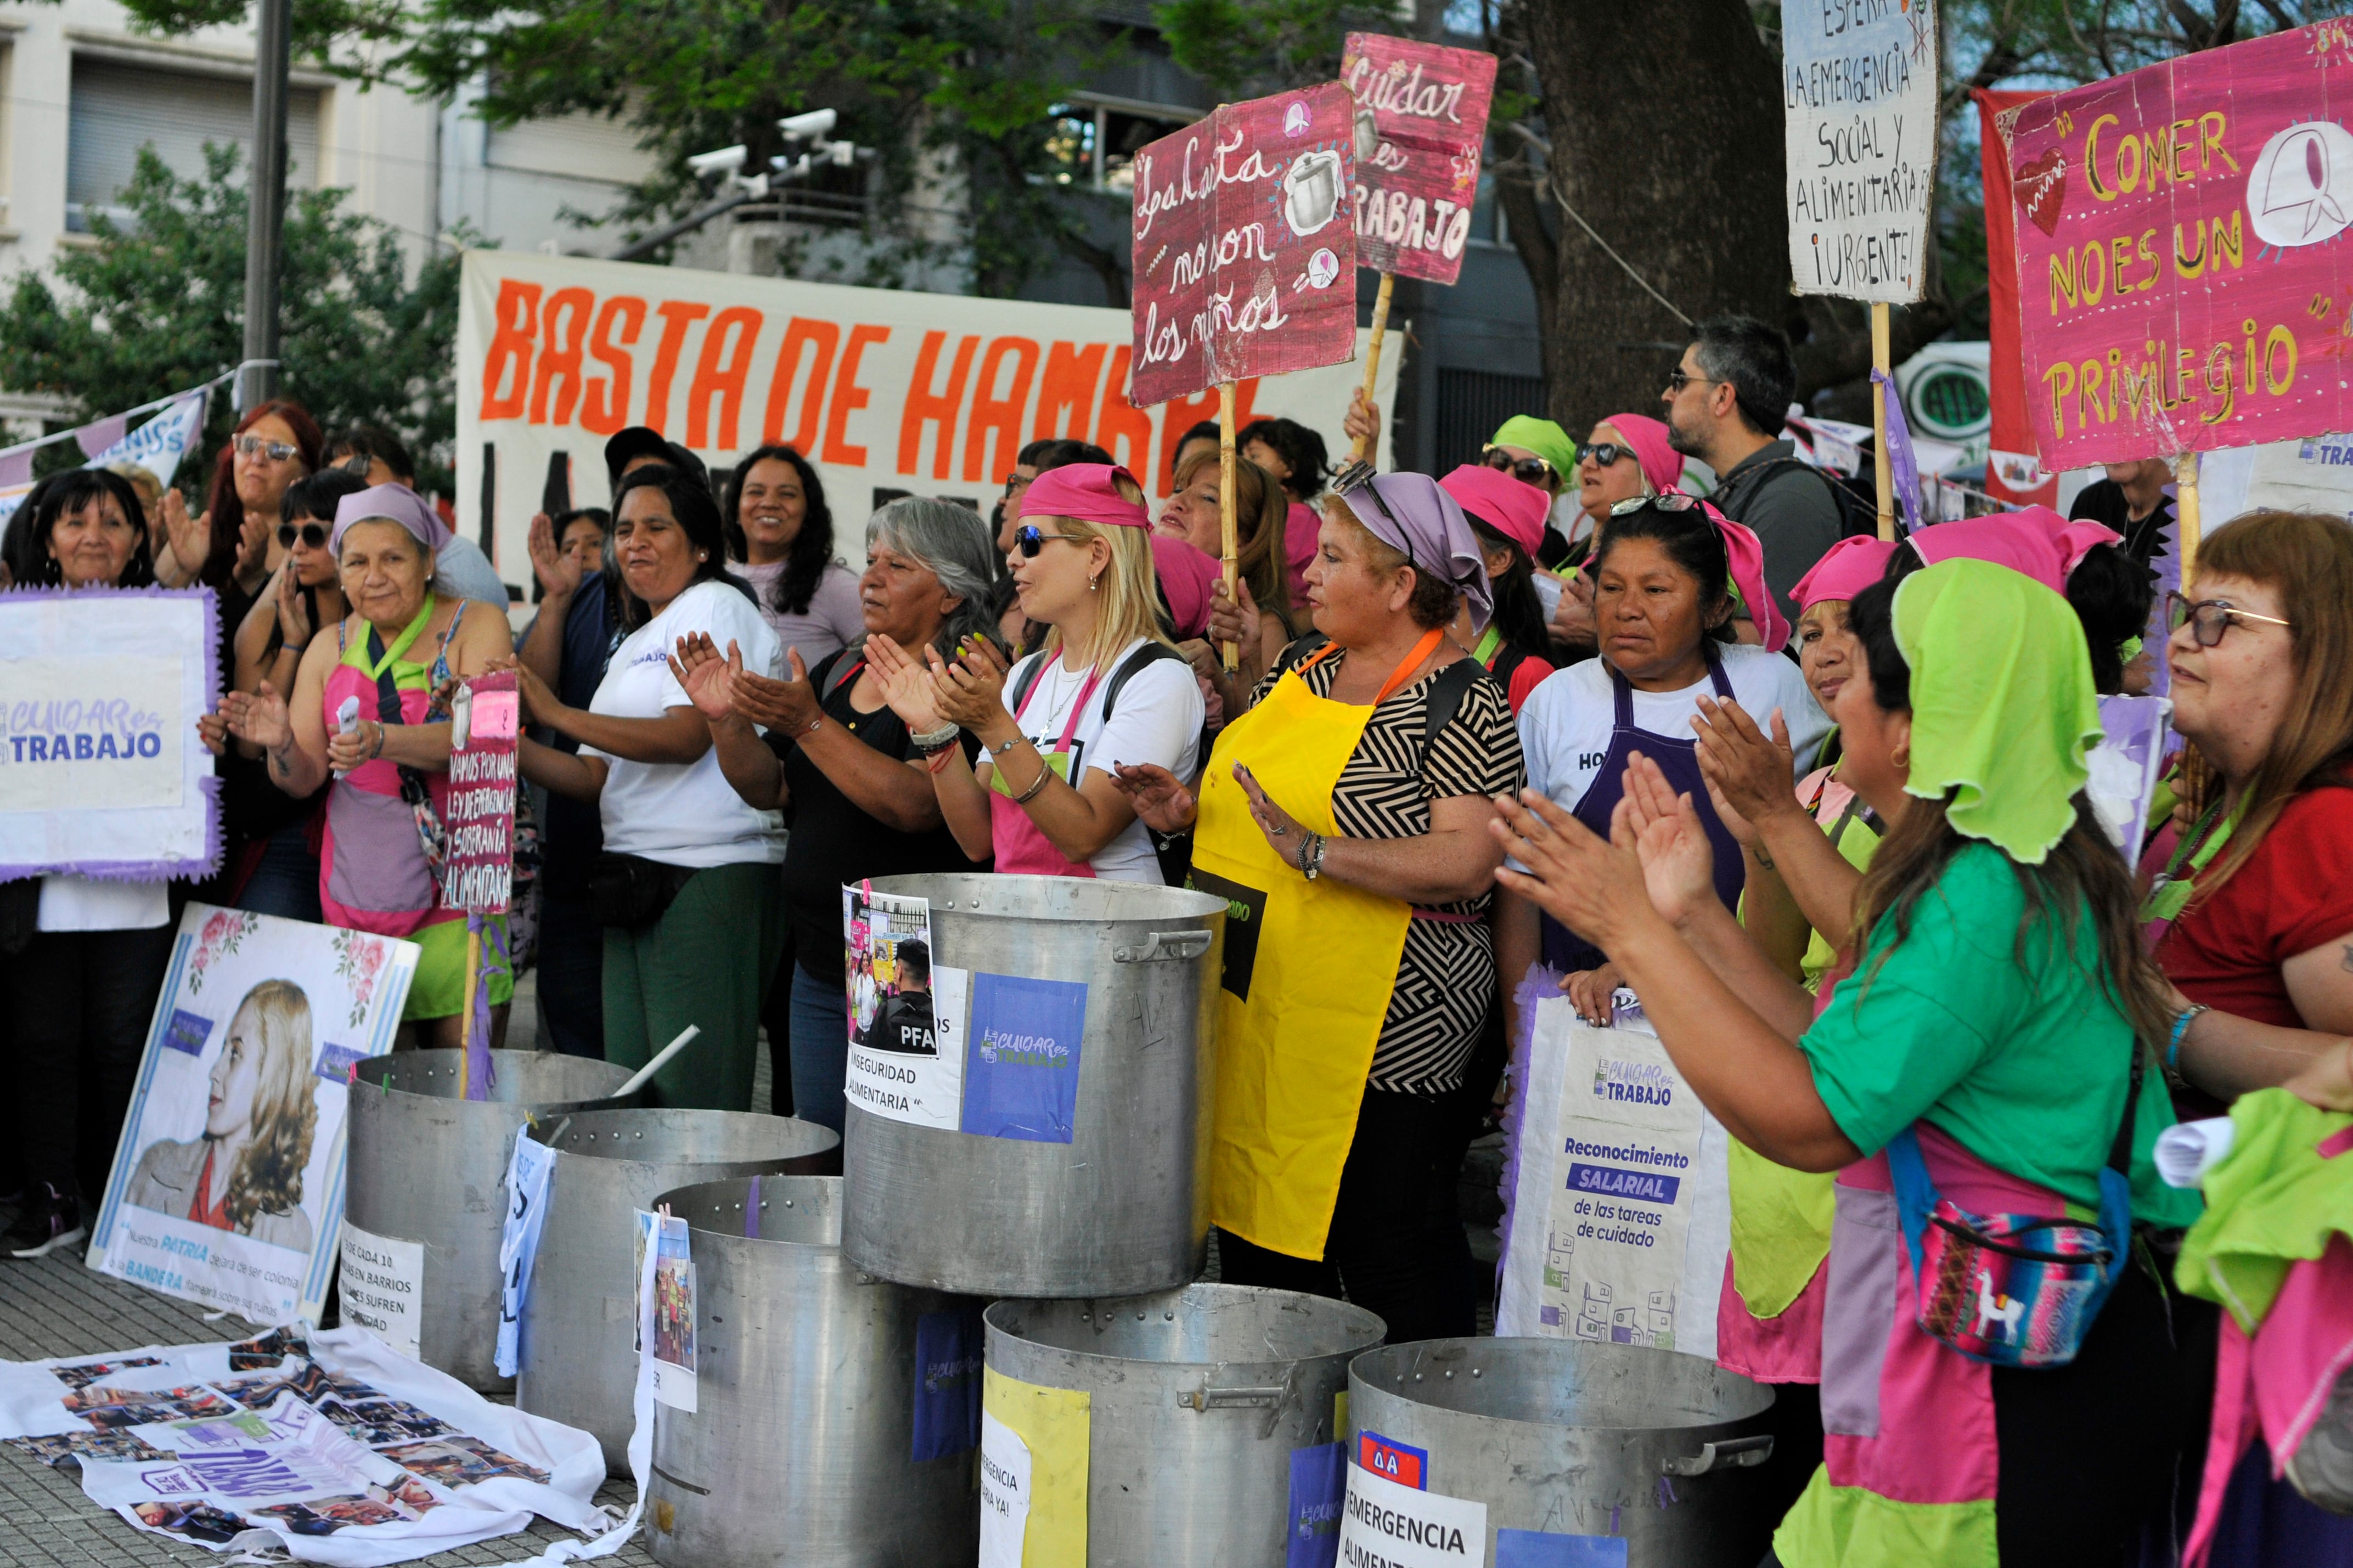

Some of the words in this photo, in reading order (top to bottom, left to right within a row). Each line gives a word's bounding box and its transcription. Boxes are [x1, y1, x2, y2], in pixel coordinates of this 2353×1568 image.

[1348, 57, 1465, 124] Cuidar
[1786, 63, 1808, 109] LA
[1894, 114, 1902, 167] Y
[1370, 142, 1408, 172] es
[1351, 184, 1471, 261] RABAJO
[2175, 210, 2243, 279] UN
[1138, 301, 1187, 370] los
[480, 278, 763, 451] BASTA
[763, 317, 891, 467] DE
[898, 329, 1275, 500] HAMBR
[10, 731, 161, 762] TRABAJO
[1579, 751, 1609, 770] HO
[450, 751, 479, 785] VAMOS
[480, 751, 496, 783] POR
[497, 751, 514, 781] UNA
[901, 1025, 936, 1048] PFA
[998, 1033, 1056, 1058] CUIDAR
[851, 1050, 916, 1084] INSEGURIDAD
[998, 1049, 1068, 1069] TRABAJO
[1609, 1061, 1663, 1091] CUIDAR
[848, 1079, 909, 1112] ALIMENTARIA
[1607, 1082, 1671, 1106] TRABAJO
[1564, 1137, 1689, 1169] Reconocimiento
[1578, 1169, 1664, 1199] SALARIAL
[1574, 1198, 1591, 1215] de
[1594, 1200, 1615, 1219] las
[1618, 1206, 1662, 1226] tareas
[161, 1234, 209, 1263] PATRIA
[1577, 1221, 1594, 1238] de
[1596, 1225, 1654, 1248] cuidado
[126, 1259, 183, 1291] BANDERA
[367, 1272, 411, 1293] BARRIOS
[366, 1293, 404, 1314] SUFREN
[995, 1495, 1010, 1518] YA!
